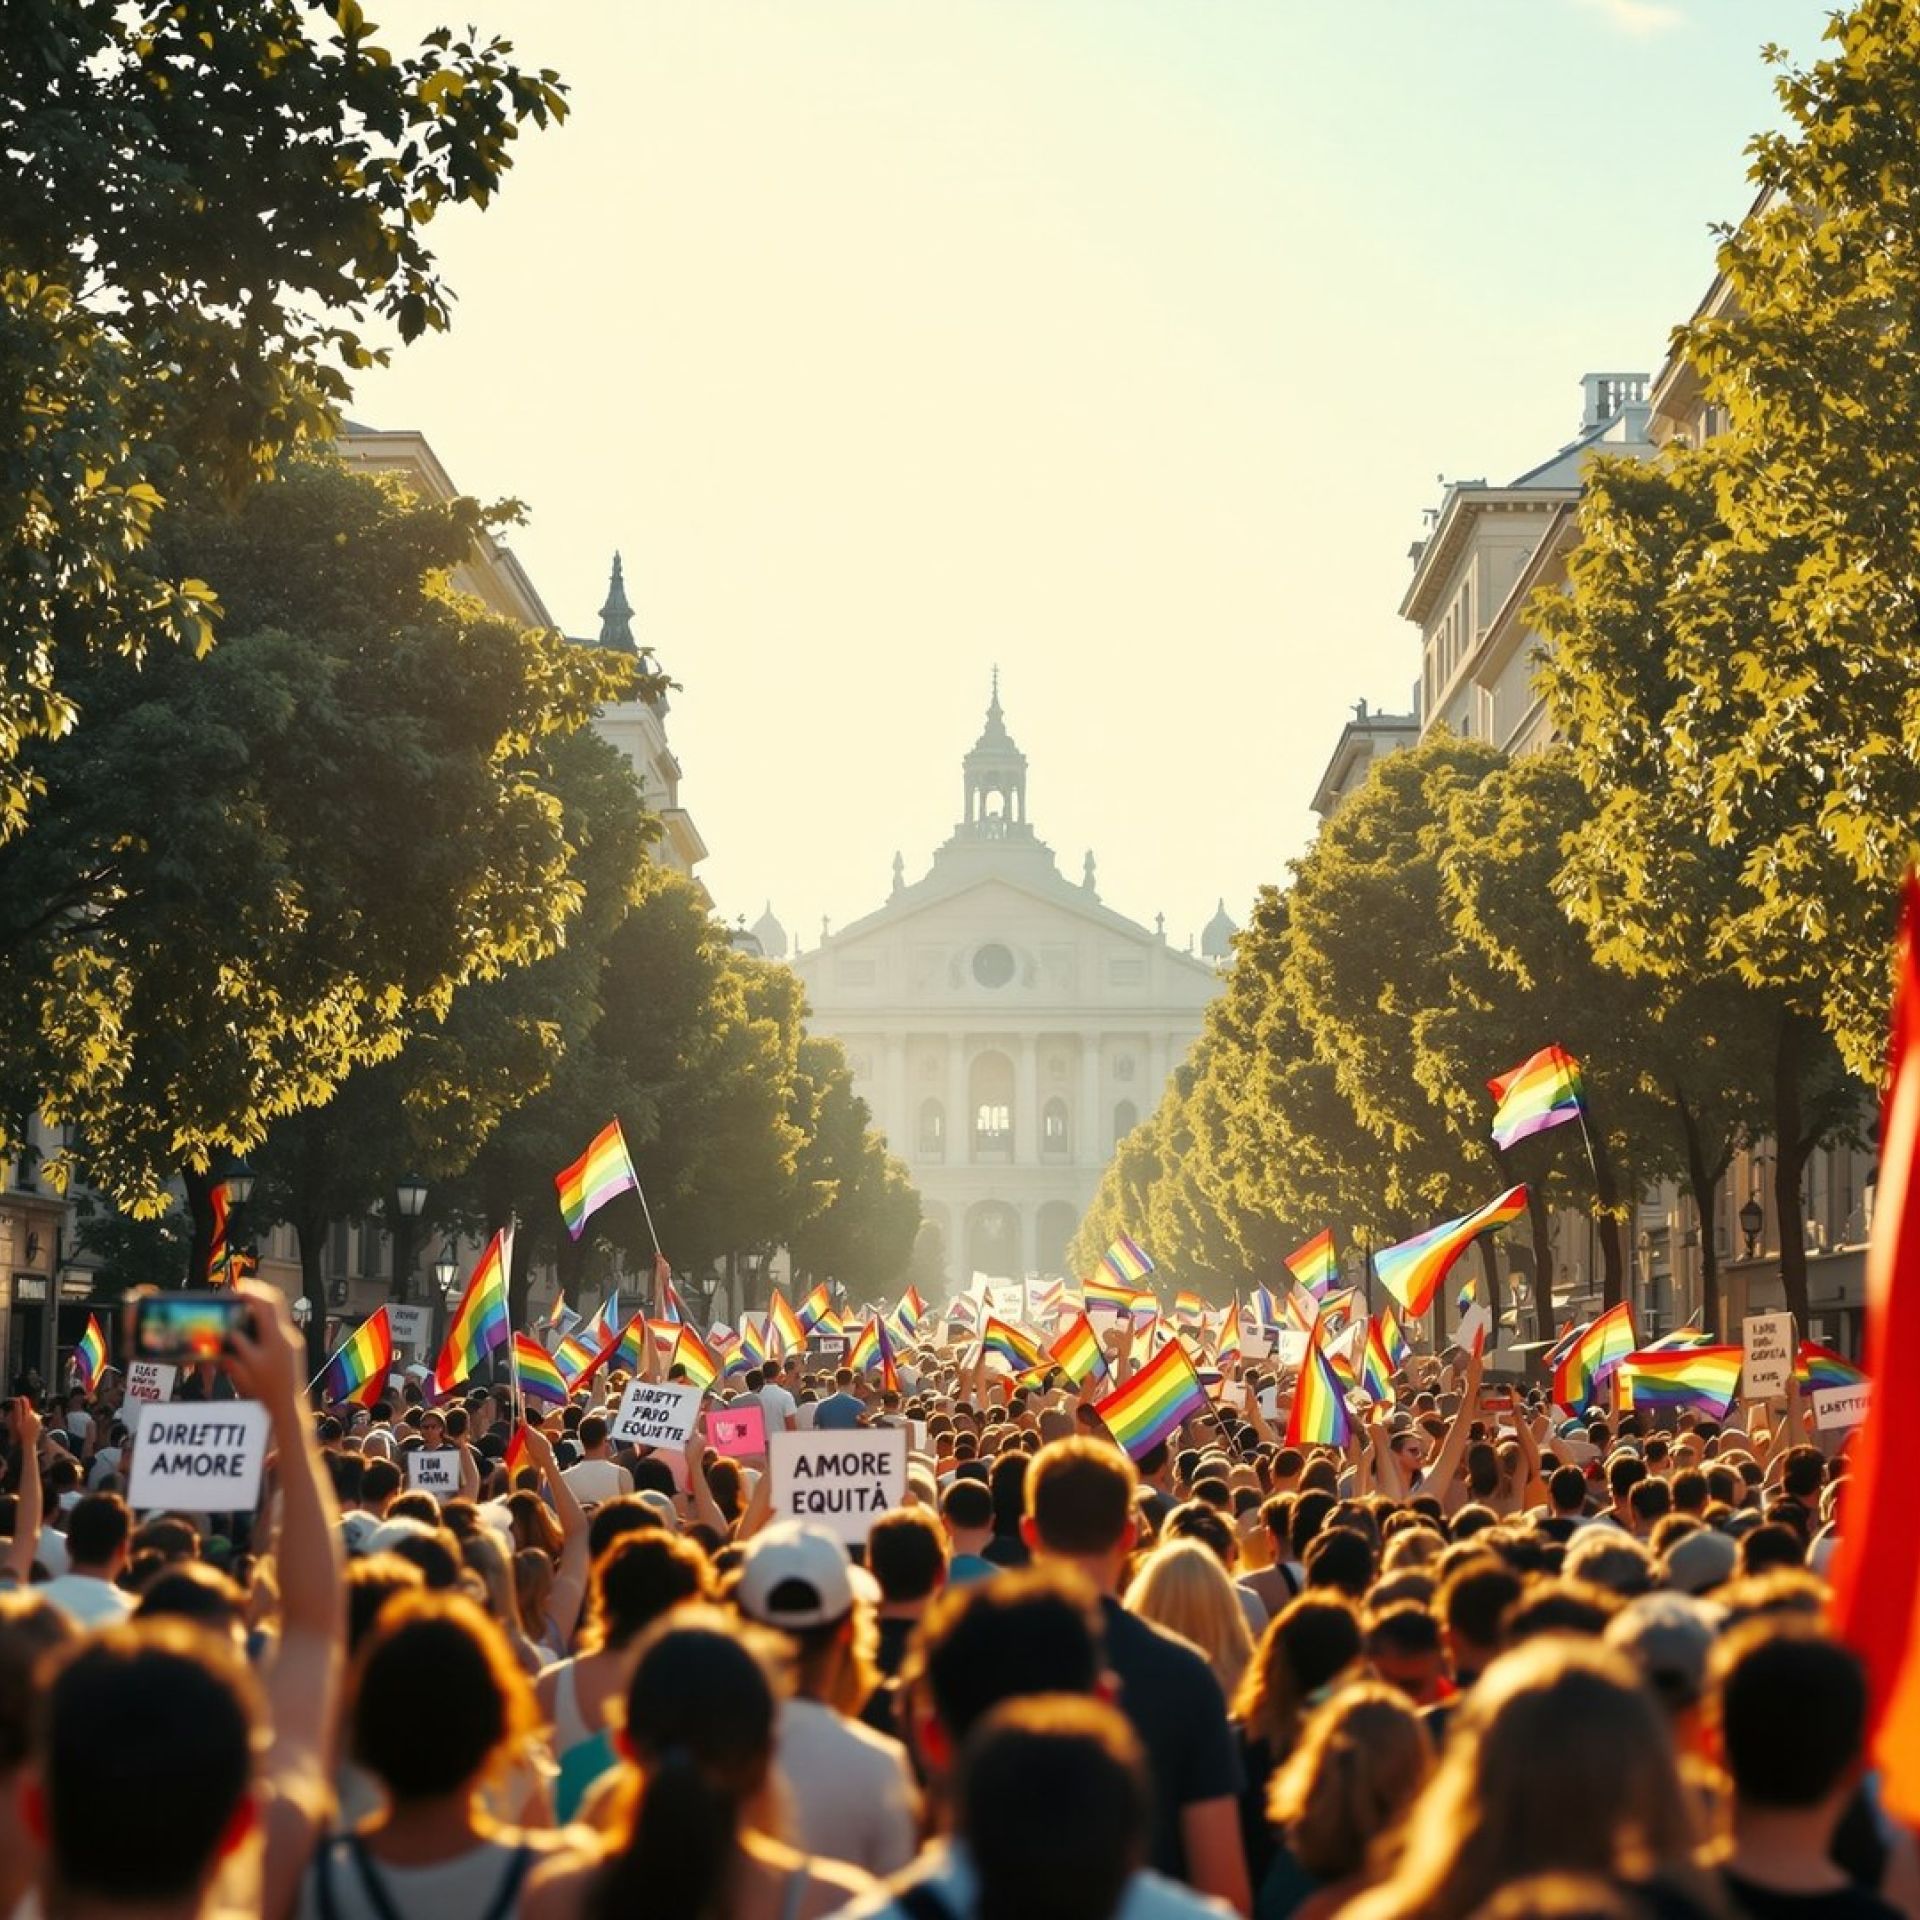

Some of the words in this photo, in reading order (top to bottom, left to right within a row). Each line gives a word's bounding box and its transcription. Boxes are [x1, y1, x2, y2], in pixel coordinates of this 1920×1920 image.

[150, 1453, 246, 1477] AMORE
[793, 1452, 892, 1479] AMORE
[792, 1481, 889, 1514] EQUITÀ
